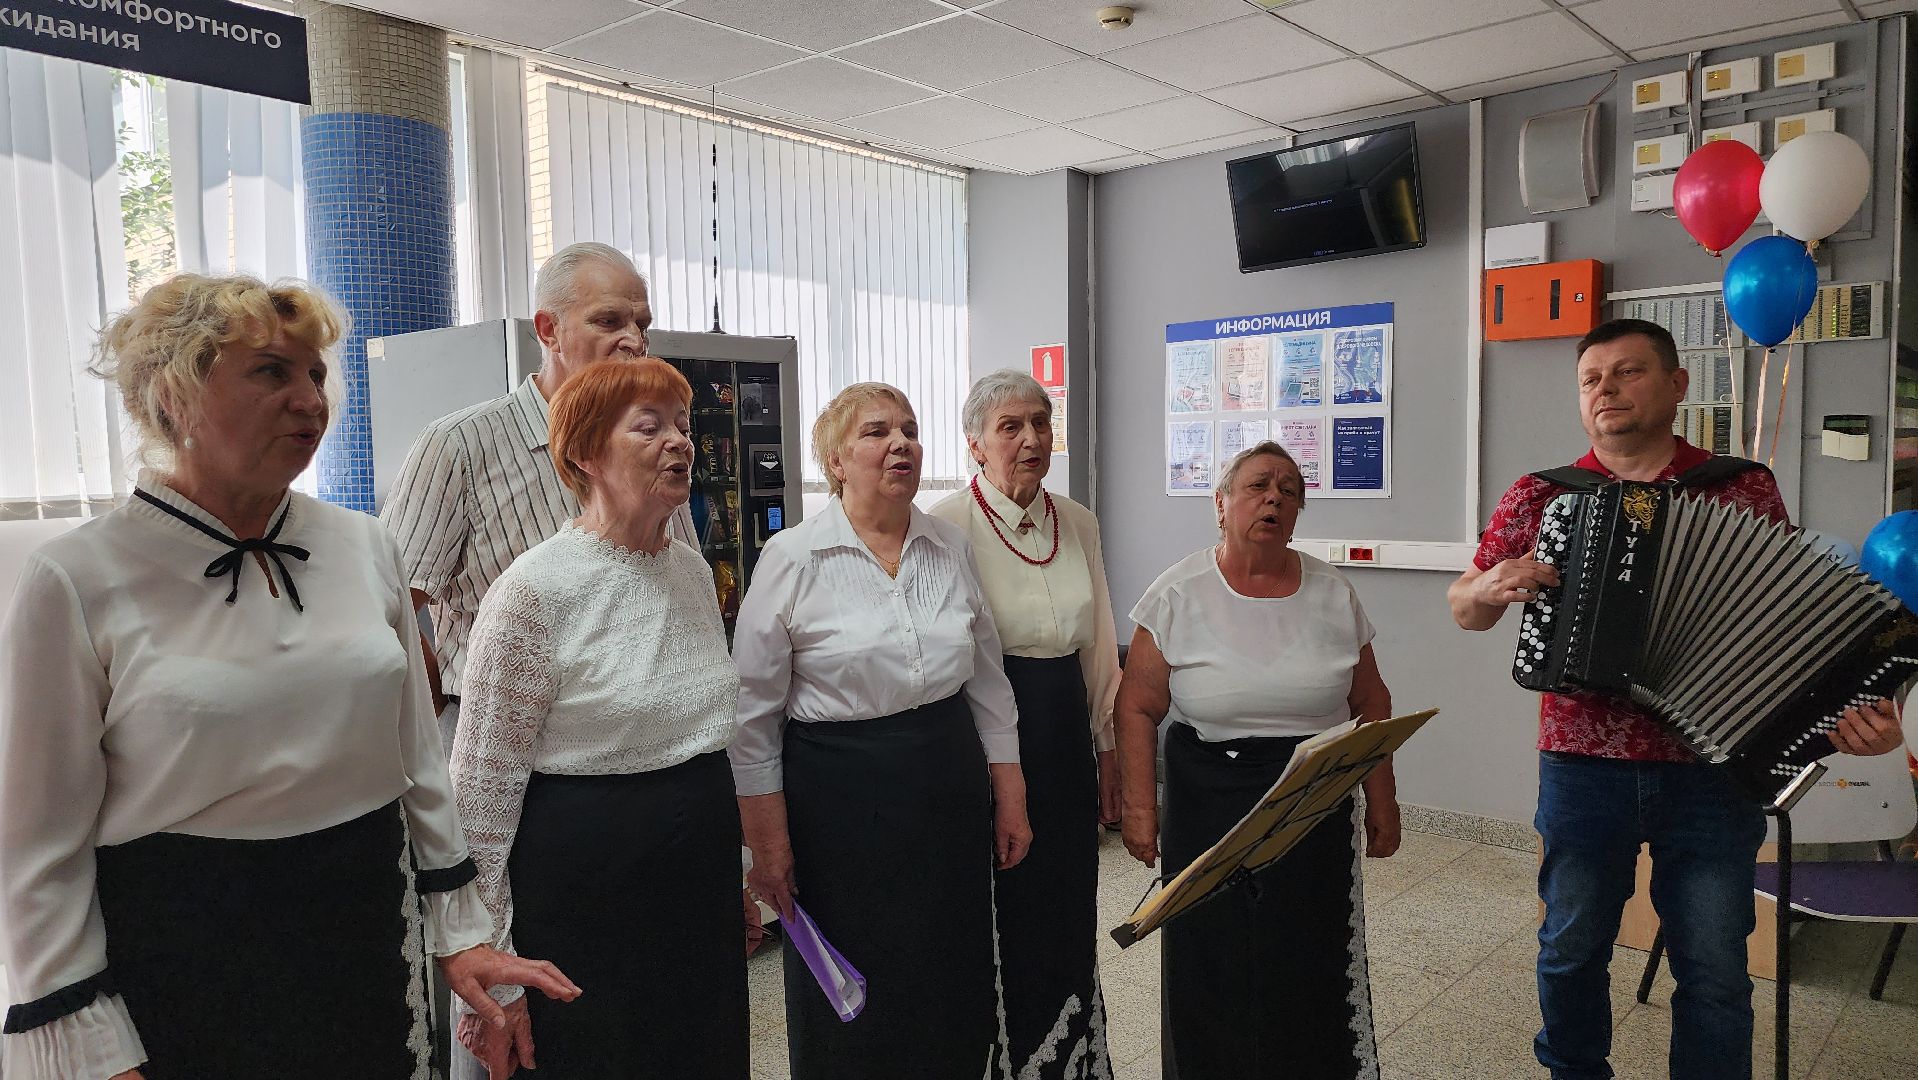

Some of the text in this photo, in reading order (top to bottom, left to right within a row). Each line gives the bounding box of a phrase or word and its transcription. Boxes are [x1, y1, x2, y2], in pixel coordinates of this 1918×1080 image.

[57, 0, 282, 49] омфортного
[1215, 310, 1331, 335] ИНФОРМАЦИЯ
[1617, 520, 1641, 582] ТУЛА
